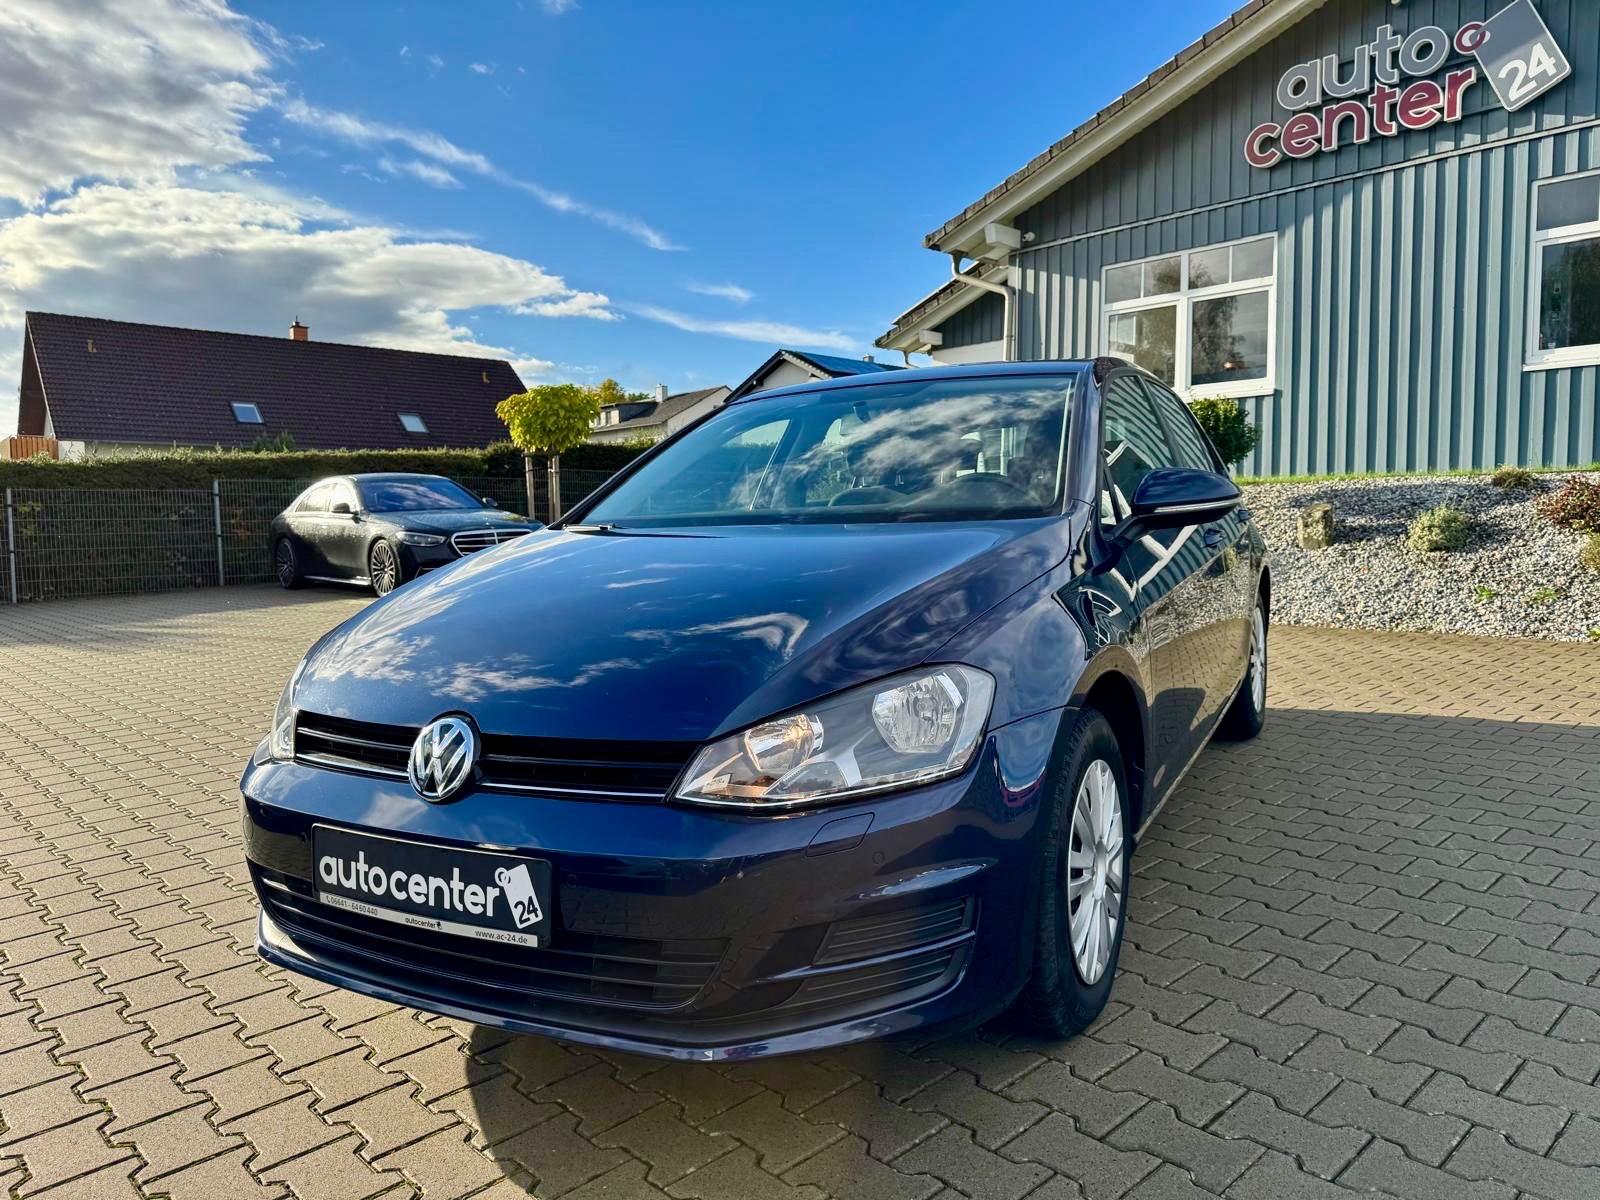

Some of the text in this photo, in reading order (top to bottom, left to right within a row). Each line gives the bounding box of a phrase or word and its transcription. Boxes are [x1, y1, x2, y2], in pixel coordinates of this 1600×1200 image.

[1276, 24, 1450, 111] auto
[1498, 42, 1557, 102] 24
[1243, 67, 1477, 168] center
[475, 930, 528, 944] www.ac-24.de
[513, 894, 540, 925] 24
